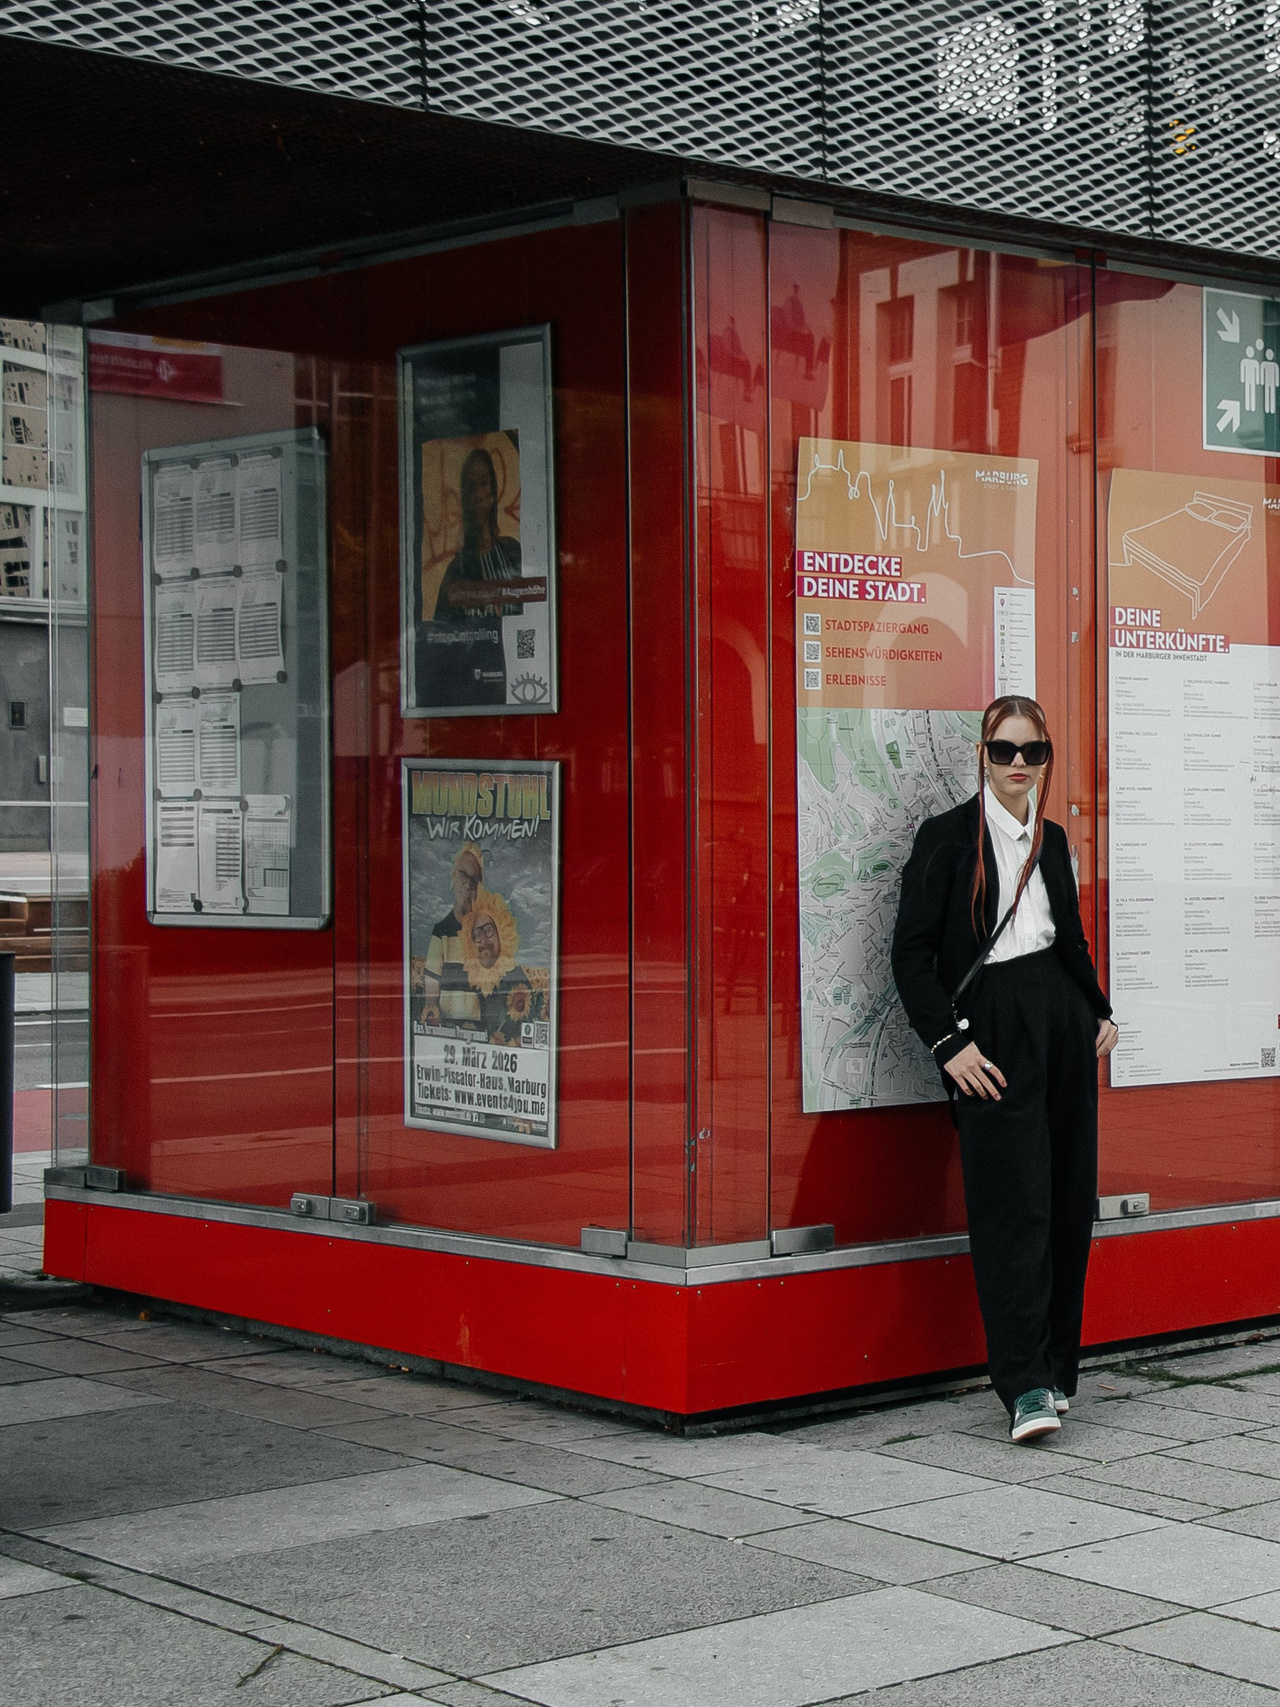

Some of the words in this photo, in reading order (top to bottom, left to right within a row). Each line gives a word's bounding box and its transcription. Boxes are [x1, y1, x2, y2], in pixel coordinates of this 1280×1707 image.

[975, 469, 1029, 486] MARBURG
[803, 552, 901, 577] ENTDECKE
[502, 585, 546, 598] #Augenhöhe
[803, 578, 859, 599] DEINE
[864, 581, 926, 603] STADT.
[825, 619, 929, 635] STADTSPAZIERGANG
[1114, 607, 1162, 628] DEINE
[1114, 629, 1229, 653] UNTERKÜNFTE.
[825, 645, 943, 662] SEHENSWÜRDIGKEITEN
[1122, 651, 1135, 659] DER
[1135, 652, 1172, 661] MARBURGER
[1172, 654, 1207, 662] INNENSTADT
[825, 673, 887, 687] ERLEBNISSE
[411, 770, 551, 821] MUNDSTUHL
[426, 816, 460, 841] WIR
[463, 814, 540, 842] KOMMEN!
[443, 1044, 459, 1066] 29.
[462, 1047, 487, 1069] März
[491, 1050, 519, 1073] 2026
[417, 1082, 452, 1102] Tickets:
[454, 1089, 546, 1116] www.events4you.me
[508, 1078, 547, 1099] Marburg
